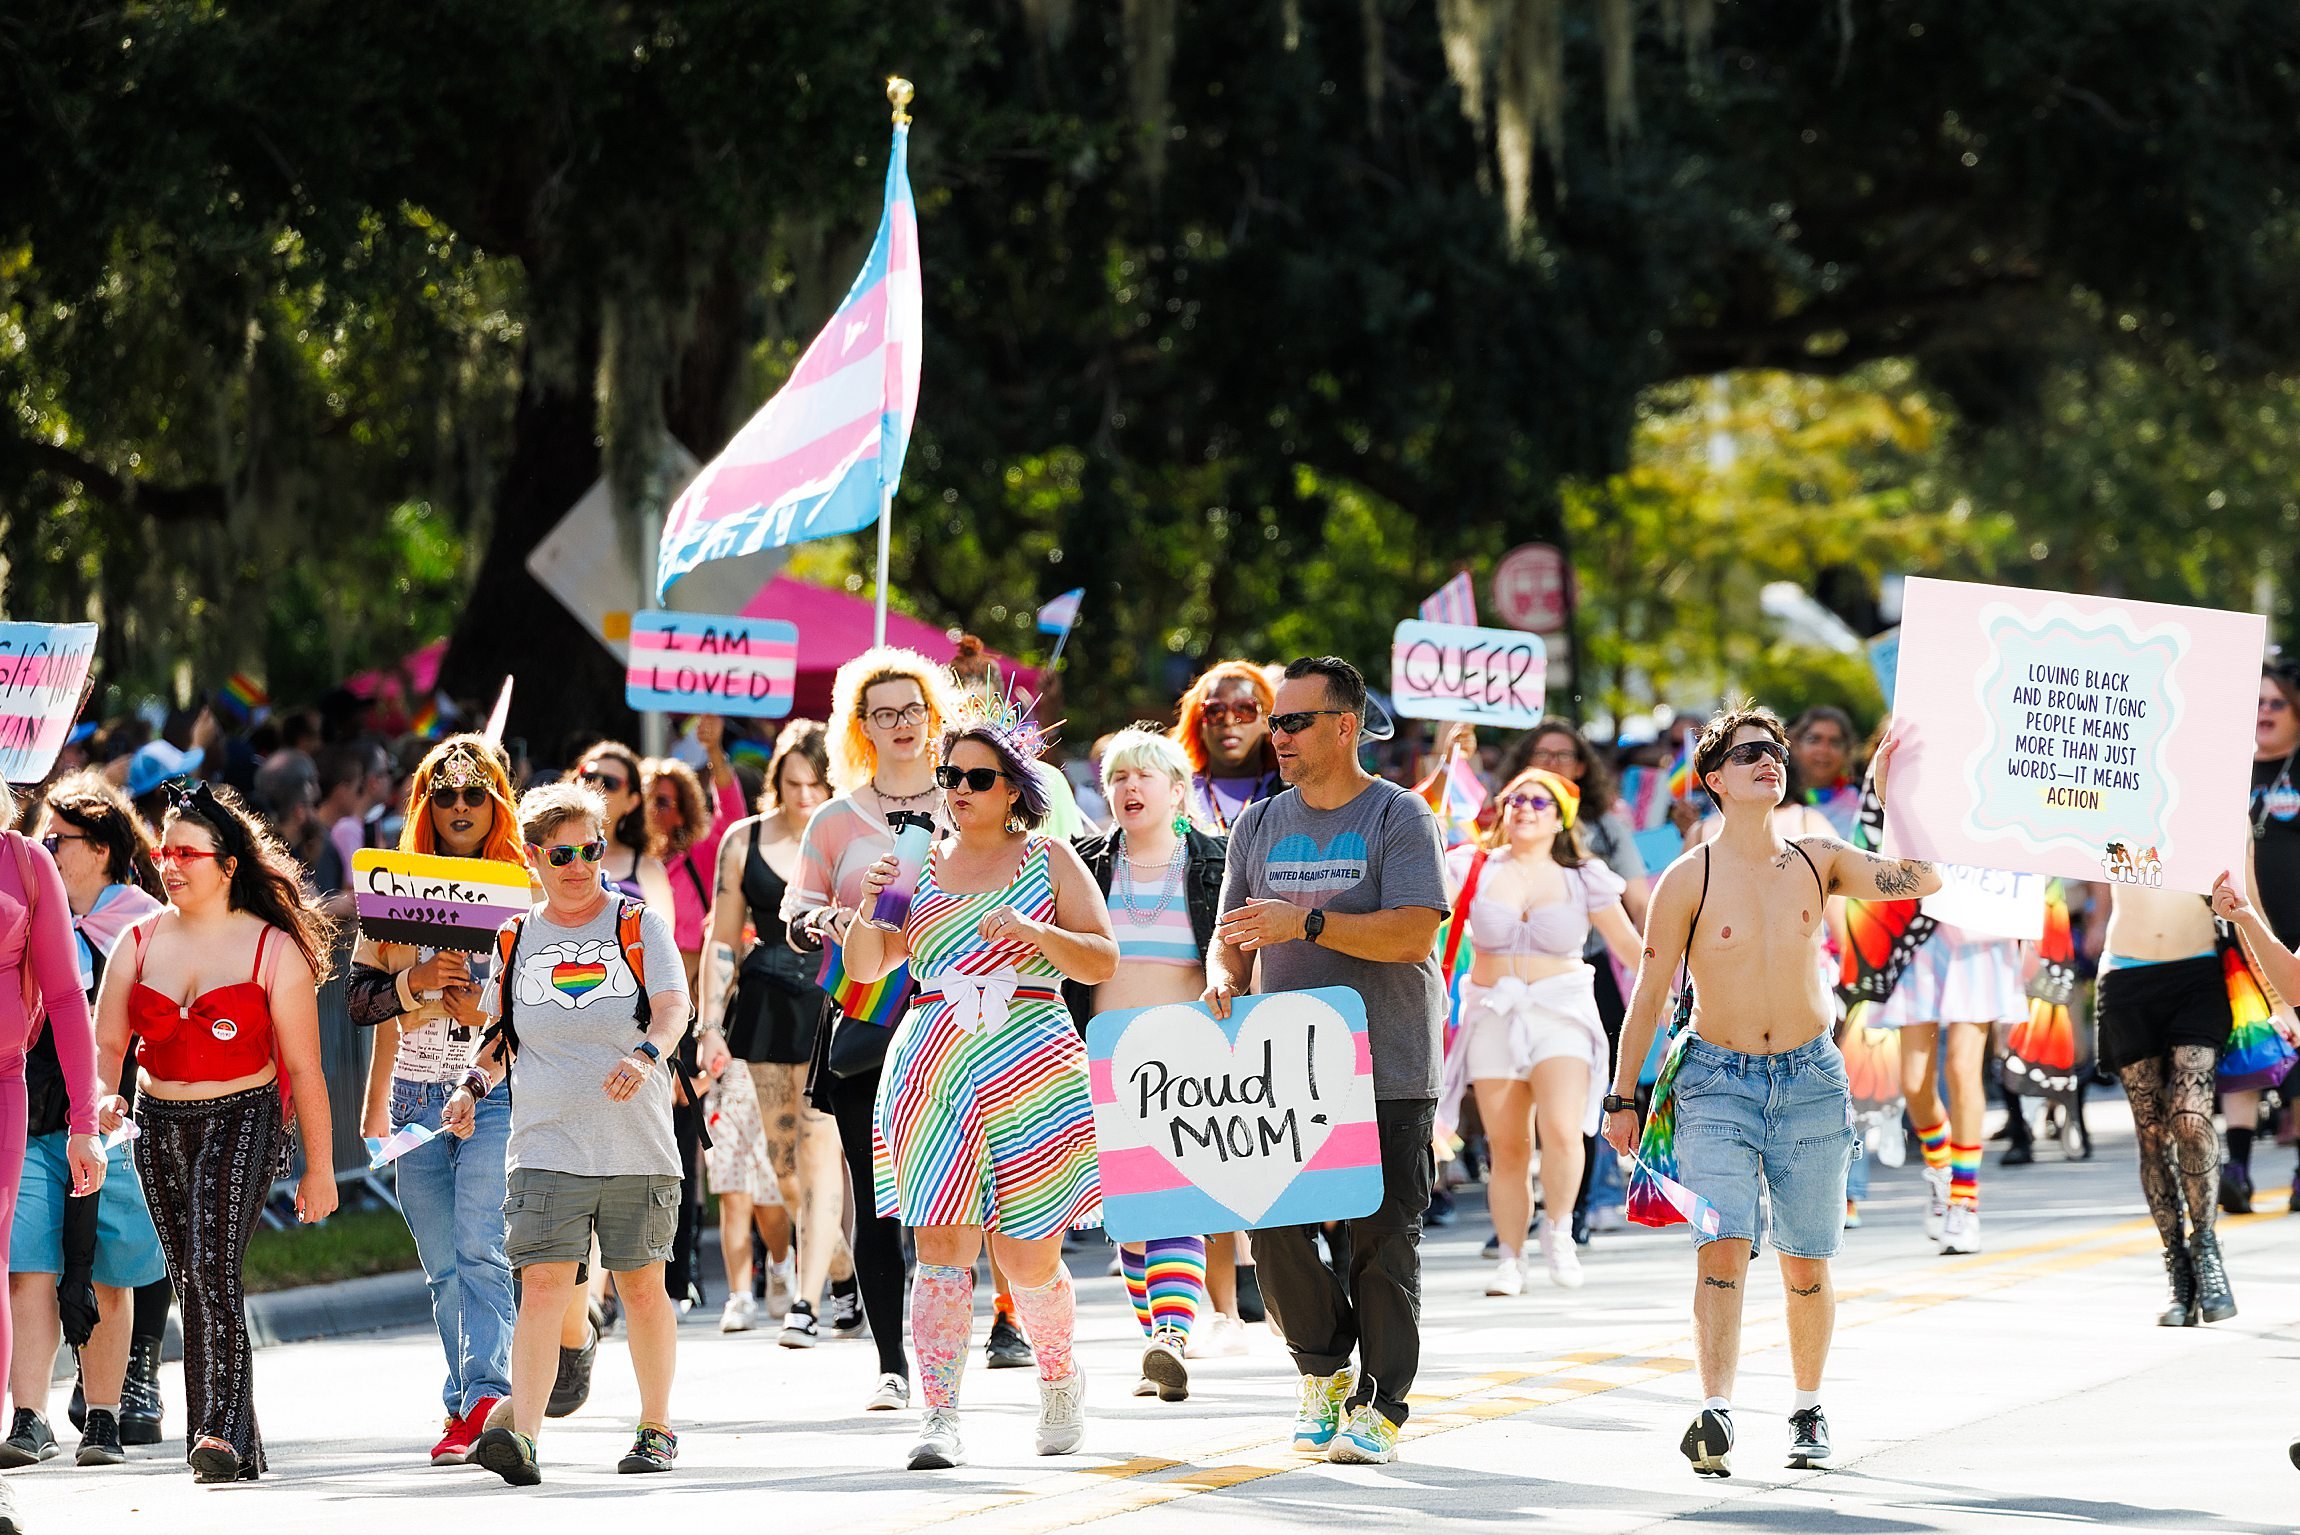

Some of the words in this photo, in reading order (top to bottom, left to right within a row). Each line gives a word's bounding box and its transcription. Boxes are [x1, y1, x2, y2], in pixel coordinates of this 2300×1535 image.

[659, 625, 681, 650] I
[699, 624, 749, 655] AM
[652, 664, 771, 702] LOVED
[1405, 639, 1539, 716] QUEER.
[2029, 663, 2079, 687] LOVING
[2085, 669, 2130, 692] BLACK
[2013, 686, 2042, 706] AND
[2048, 689, 2098, 713] BROWN
[2105, 696, 2147, 718] T/GNC
[2026, 711, 2076, 735] PEOPLE
[2082, 718, 2130, 741] MEANS
[2015, 734, 2055, 757] MORE
[2062, 739, 2098, 761] THAN
[2104, 745, 2137, 766] JUST
[2093, 768, 2140, 791] MEANS
[2047, 786, 2099, 810] ACTION
[1269, 870, 1299, 881] UNITED
[1298, 869, 1330, 881] AGAINST
[1330, 868, 1351, 879] HATE
[1128, 1039, 1276, 1119] Proud
[1169, 1108, 1302, 1163] MOM
